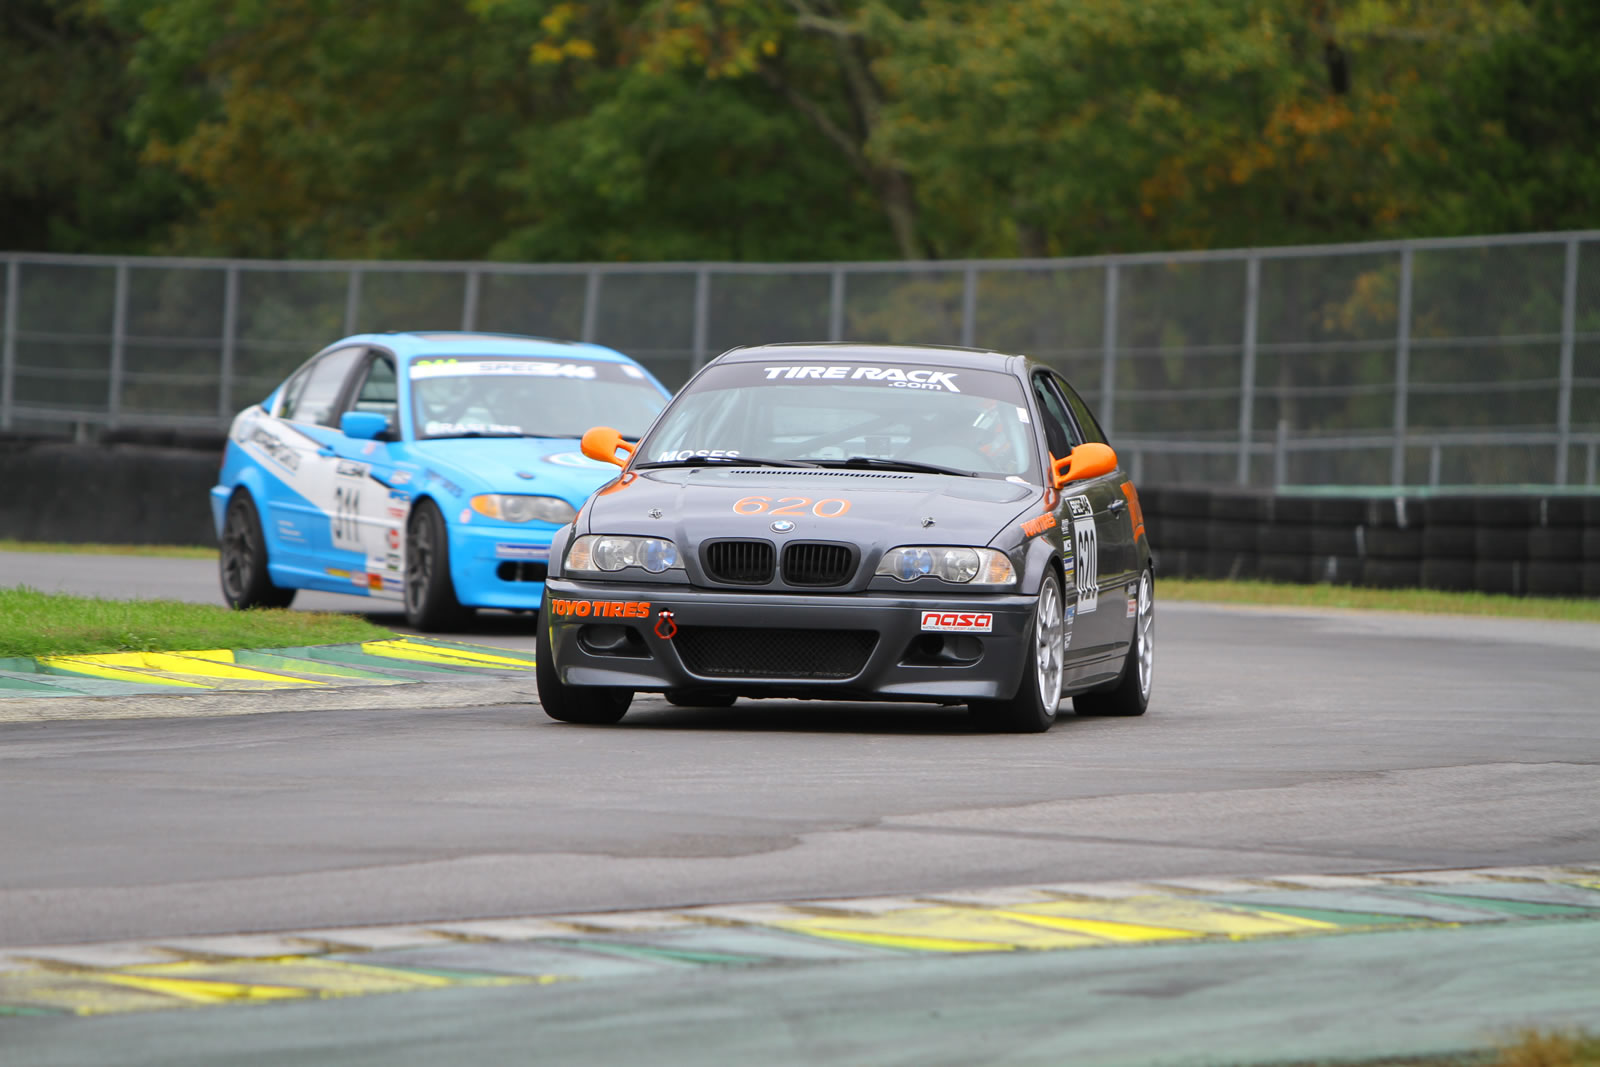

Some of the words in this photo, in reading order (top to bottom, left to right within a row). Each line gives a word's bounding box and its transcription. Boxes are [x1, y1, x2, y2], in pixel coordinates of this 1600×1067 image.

[763, 366, 852, 380] TIRE
[851, 367, 961, 393] RACK
[888, 381, 942, 391] .com
[657, 449, 740, 463] MOSES
[732, 495, 852, 518] 620
[1078, 529, 1096, 601] 620
[552, 599, 592, 617] TOYO
[592, 601, 651, 618] TIRES
